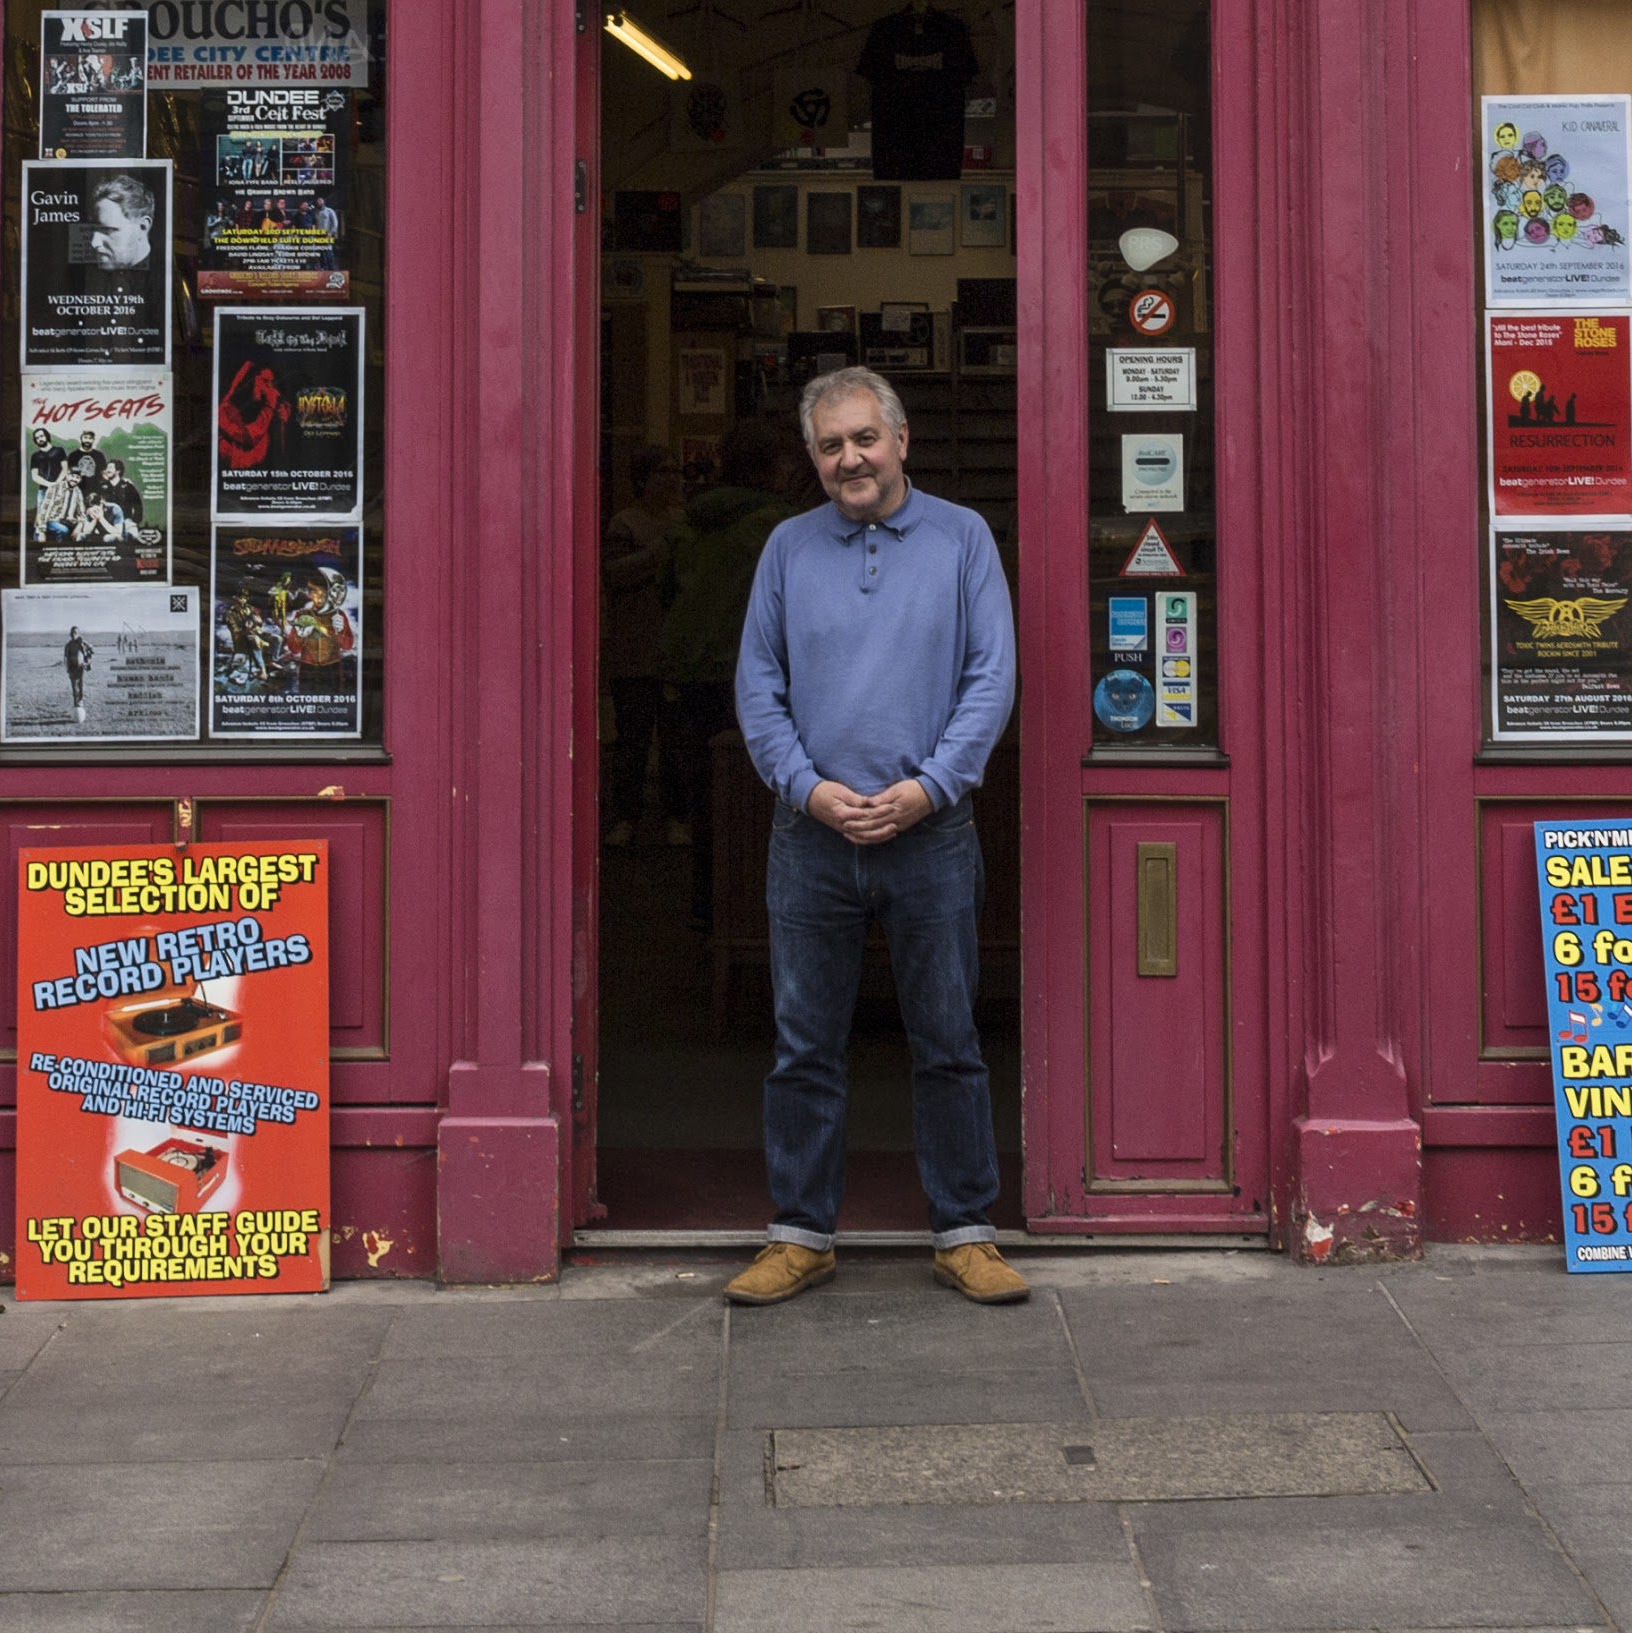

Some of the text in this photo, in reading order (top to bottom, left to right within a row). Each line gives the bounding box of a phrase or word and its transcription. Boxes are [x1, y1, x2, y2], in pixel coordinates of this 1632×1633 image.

[83, 0, 351, 40] OUCHO'S
[194, 44, 351, 63] CITY CENTRE
[174, 64, 233, 80] RETAILER
[236, 64, 253, 79] OF
[256, 64, 280, 79] THE
[284, 64, 316, 79] YEAR
[320, 64, 351, 79] 2008
[227, 90, 320, 104] DUNDEE
[232, 106, 250, 114] 3rd
[292, 105, 327, 120] Fest
[1562, 120, 1621, 132] KID CANAVERAL
[30, 191, 79, 206] Gavin
[34, 209, 80, 223] James
[48, 295, 144, 305] WEDNESDAY 19th
[57, 306, 135, 315] OCTOBER 2016
[1574, 318, 1599, 328] THE
[1574, 328, 1616, 338] STONE
[1574, 337, 1617, 348] ROSES
[1119, 356, 1183, 364] OPENING HOURS
[32, 393, 165, 425] HOT SEATS
[1509, 434, 1615, 449] RESURRECTION
[1114, 653, 1142, 662] PUSH
[27, 854, 319, 891] DUNDEE'S LARGEST
[1545, 855, 1632, 888] SALE
[65, 881, 279, 916] SELECTION OF
[1551, 894, 1599, 926] £1
[74, 917, 262, 975] NEW RETRO
